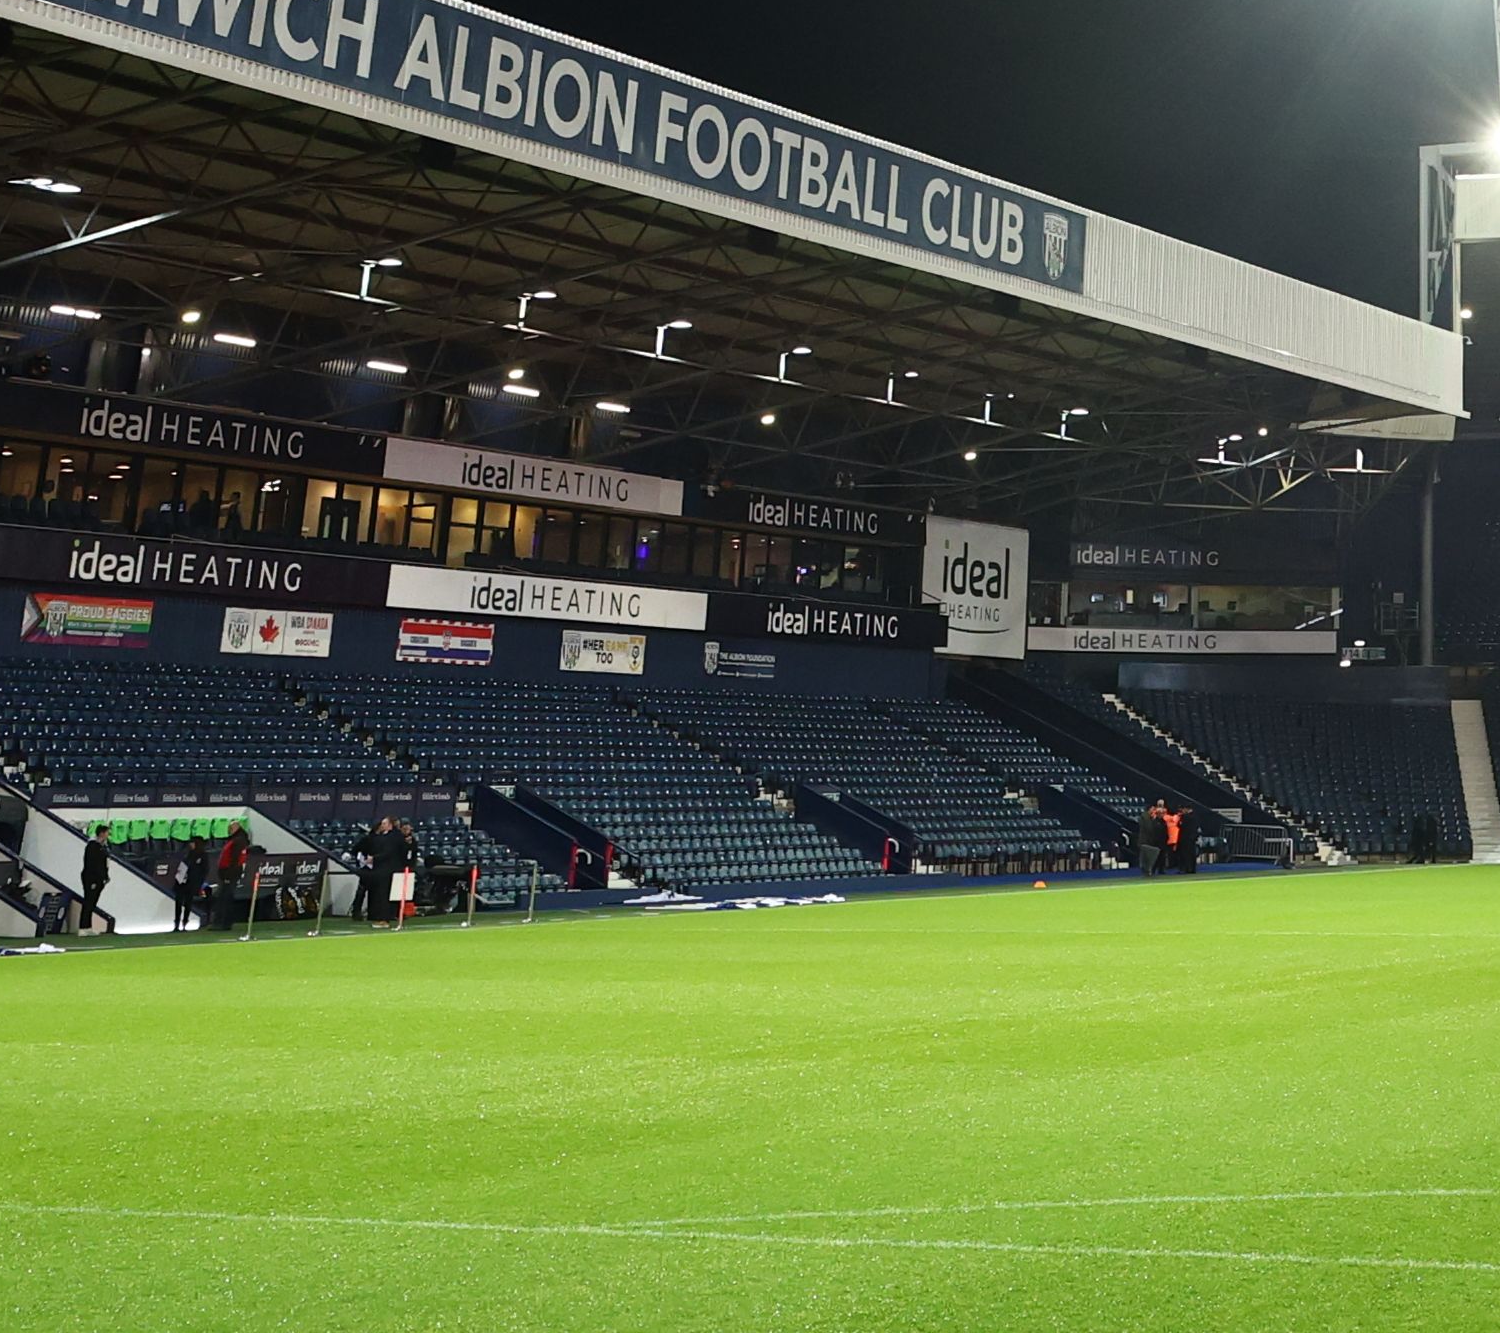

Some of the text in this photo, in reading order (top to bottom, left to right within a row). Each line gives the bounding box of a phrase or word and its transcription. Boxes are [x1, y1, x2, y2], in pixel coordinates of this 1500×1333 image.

[394, 13, 639, 154] ALBION
[654, 90, 909, 234] FOOTBALL
[921, 178, 1025, 265] CLUB
[80, 397, 305, 459] ideal HEATING
[461, 453, 629, 502] ideal HEATING
[749, 494, 879, 534] ideal HEATING
[69, 539, 303, 592] ideal HEATING
[942, 539, 1011, 600] ideal
[1076, 544, 1219, 566] ideal HEATING
[69, 605, 105, 619] PROUD
[106, 607, 150, 622] BAGGIES
[470, 576, 641, 618] ideal HEATING
[949, 604, 1001, 622] HEATING
[767, 603, 899, 638] ideal HEATING
[596, 652, 613, 664] TOO
[1074, 632, 1217, 650] ideal HEATING
